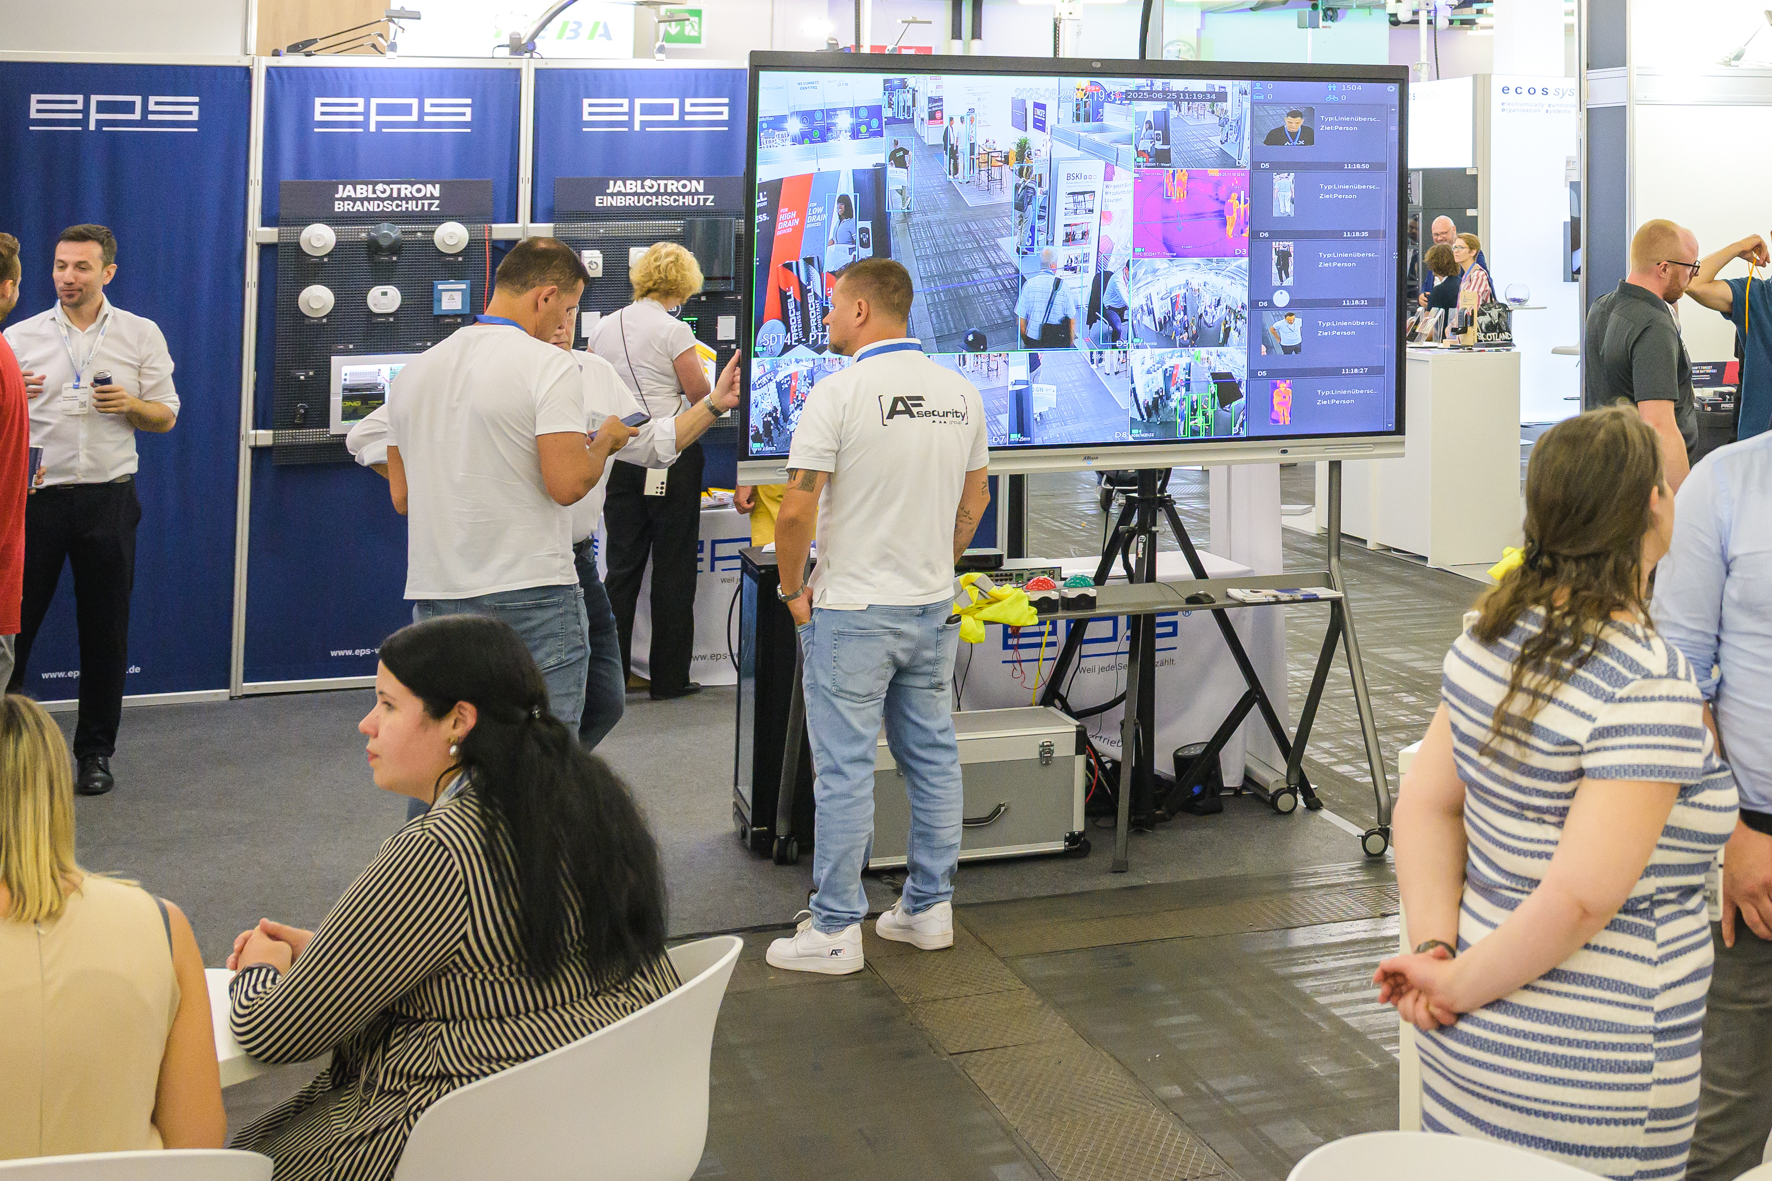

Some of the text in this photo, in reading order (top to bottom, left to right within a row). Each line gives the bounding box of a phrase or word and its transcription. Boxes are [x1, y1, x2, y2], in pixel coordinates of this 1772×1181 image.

[1127, 92, 1216, 100] 2025-06-25 11:19:34
[1553, 87, 1575, 99] sys
[1501, 101, 1545, 109] electronically
[29, 94, 199, 130] eps
[314, 97, 472, 132] eps
[582, 97, 729, 131] eps
[334, 182, 440, 199] JABLOTRON
[606, 179, 705, 193] JABLOTRON
[334, 200, 441, 212] BRANDSCHUTZ
[595, 195, 715, 207] EINBRUCHSCHUTZ
[779, 211, 797, 222] HIGH
[808, 206, 825, 216] LOW
[778, 218, 800, 230] DRAIN
[807, 213, 828, 223] DRAIN
[806, 280, 818, 335] PROCELL
[814, 299, 823, 332] CONSTANT
[763, 333, 799, 346] SDT4E
[1477, 332, 1512, 341] SCOTLAND
[1078, 665, 1096, 675] Weil
[1097, 663, 1115, 675] jede
